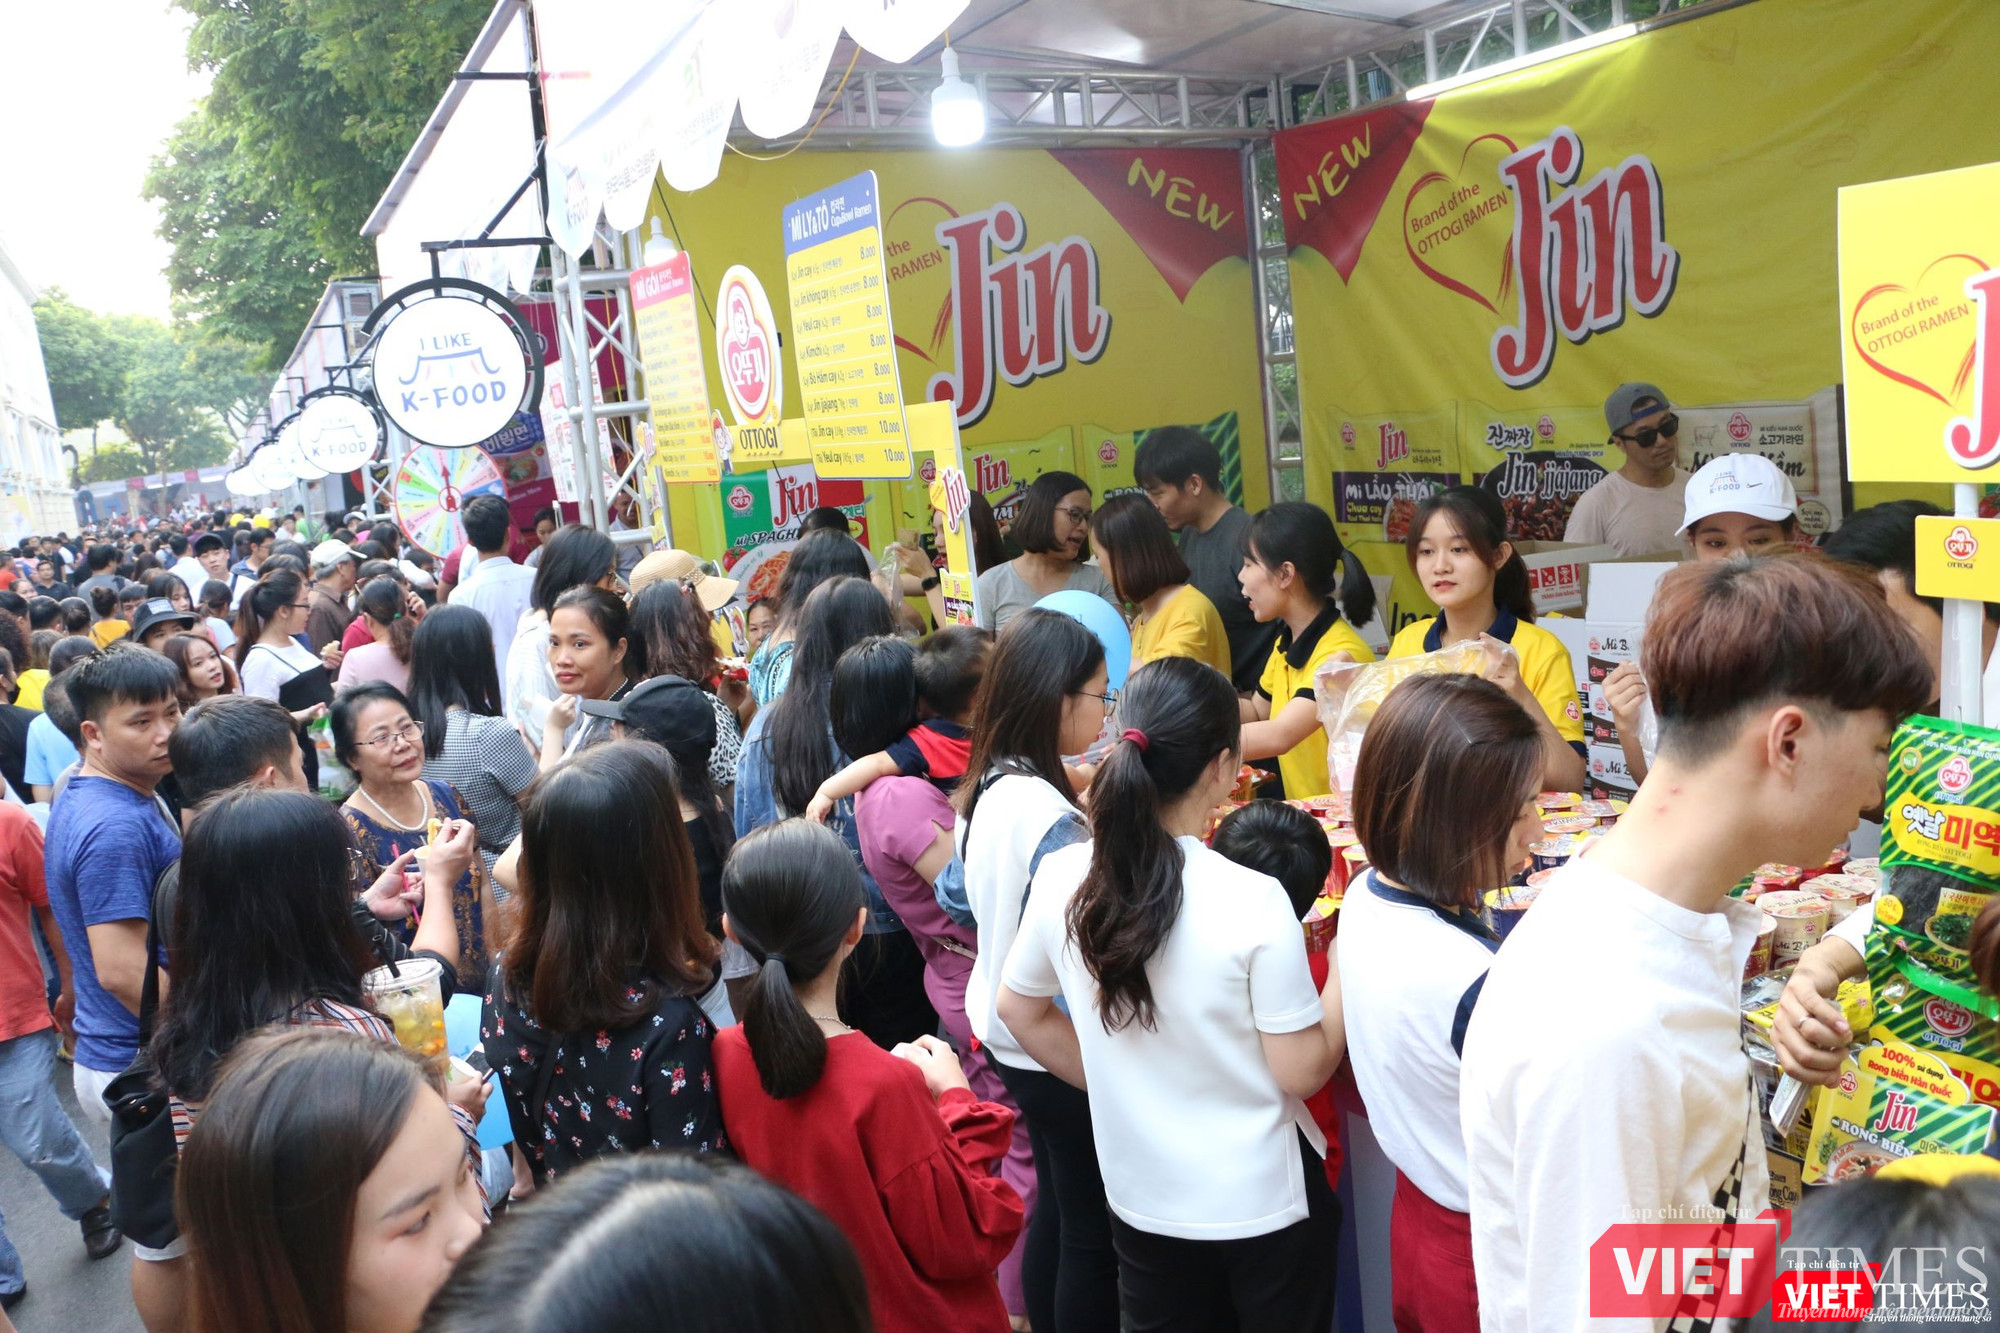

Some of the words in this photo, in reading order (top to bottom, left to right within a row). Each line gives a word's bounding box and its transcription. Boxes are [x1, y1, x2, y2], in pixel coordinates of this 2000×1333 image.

[1292, 122, 1372, 221] NEW
[1128, 158, 1233, 232] NEW
[854, 203, 873, 220] Ramen
[1411, 202, 1447, 234] Brand
[1447, 194, 1460, 216] of
[1457, 183, 1480, 209] the
[1417, 216, 1465, 256] OTTOGI
[1464, 190, 1508, 232] RAMEN
[860, 245, 876, 260] 8.000
[886, 240, 911, 257] the
[1493, 128, 1677, 384] Jin
[893, 250, 943, 281] RAMEN
[645, 271, 660, 297] GÓI
[863, 274, 879, 290] 8.000
[813, 318, 821, 332] cay
[866, 304, 883, 319] 8.000
[930, 206, 1106, 421] Jin
[1861, 309, 1899, 335] Brand
[1901, 302, 1914, 319] of
[1917, 295, 1939, 313] the
[1868, 324, 1918, 354] OTTOGI
[1918, 303, 1969, 332] RAMEN
[420, 338, 425, 351] I
[433, 333, 472, 350] LIKE
[806, 346, 821, 359] Kimchi
[870, 334, 886, 347] 8.000
[828, 371, 837, 384] cay
[874, 362, 891, 376] 8.000
[401, 381, 506, 413] K-FOOD
[813, 397, 821, 411] Jin
[878, 391, 895, 405] 8.000
[740, 426, 778, 449] OTTOGI
[818, 425, 826, 437] Jin
[826, 426, 835, 439] cay
[879, 420, 900, 433] 10.000
[1487, 422, 1532, 448] 진짜장
[1758, 434, 1804, 446] 소고기라면
[312, 441, 367, 458] K-FOOD
[822, 451, 833, 463] Yeul
[833, 452, 842, 465] cay
[884, 448, 905, 462] 10.000
[1377, 421, 1408, 470] Jin
[973, 453, 1011, 495] Jin
[1365, 474, 1392, 500] LẨU
[1498, 451, 1538, 497] Jin
[774, 475, 818, 527] Jin
[942, 467, 968, 531] Jin
[1710, 483, 1741, 494] K-FOOD
[1602, 637, 1618, 650] Mì
[1923, 739, 1939, 748] 100%
[1934, 791, 1964, 805] OTTOGI
[1902, 804, 1946, 841] 옛날
[1944, 815, 2000, 857] 미역
[1945, 847, 1971, 859] OTTOGI
[1932, 1008, 1965, 1027] 오뚜기
[1922, 1032, 1963, 1052] OTTOGI
[1882, 1047, 1916, 1068] 100%
[1926, 1067, 1944, 1080] dụng
[1868, 1059, 1889, 1075] Rong
[1891, 1065, 1910, 1083] biển
[1910, 1075, 1928, 1090] Hàn
[1929, 1083, 1953, 1099] Quốc
[1875, 1091, 1918, 1132] Jin
[1841, 1121, 1880, 1144] RONG
